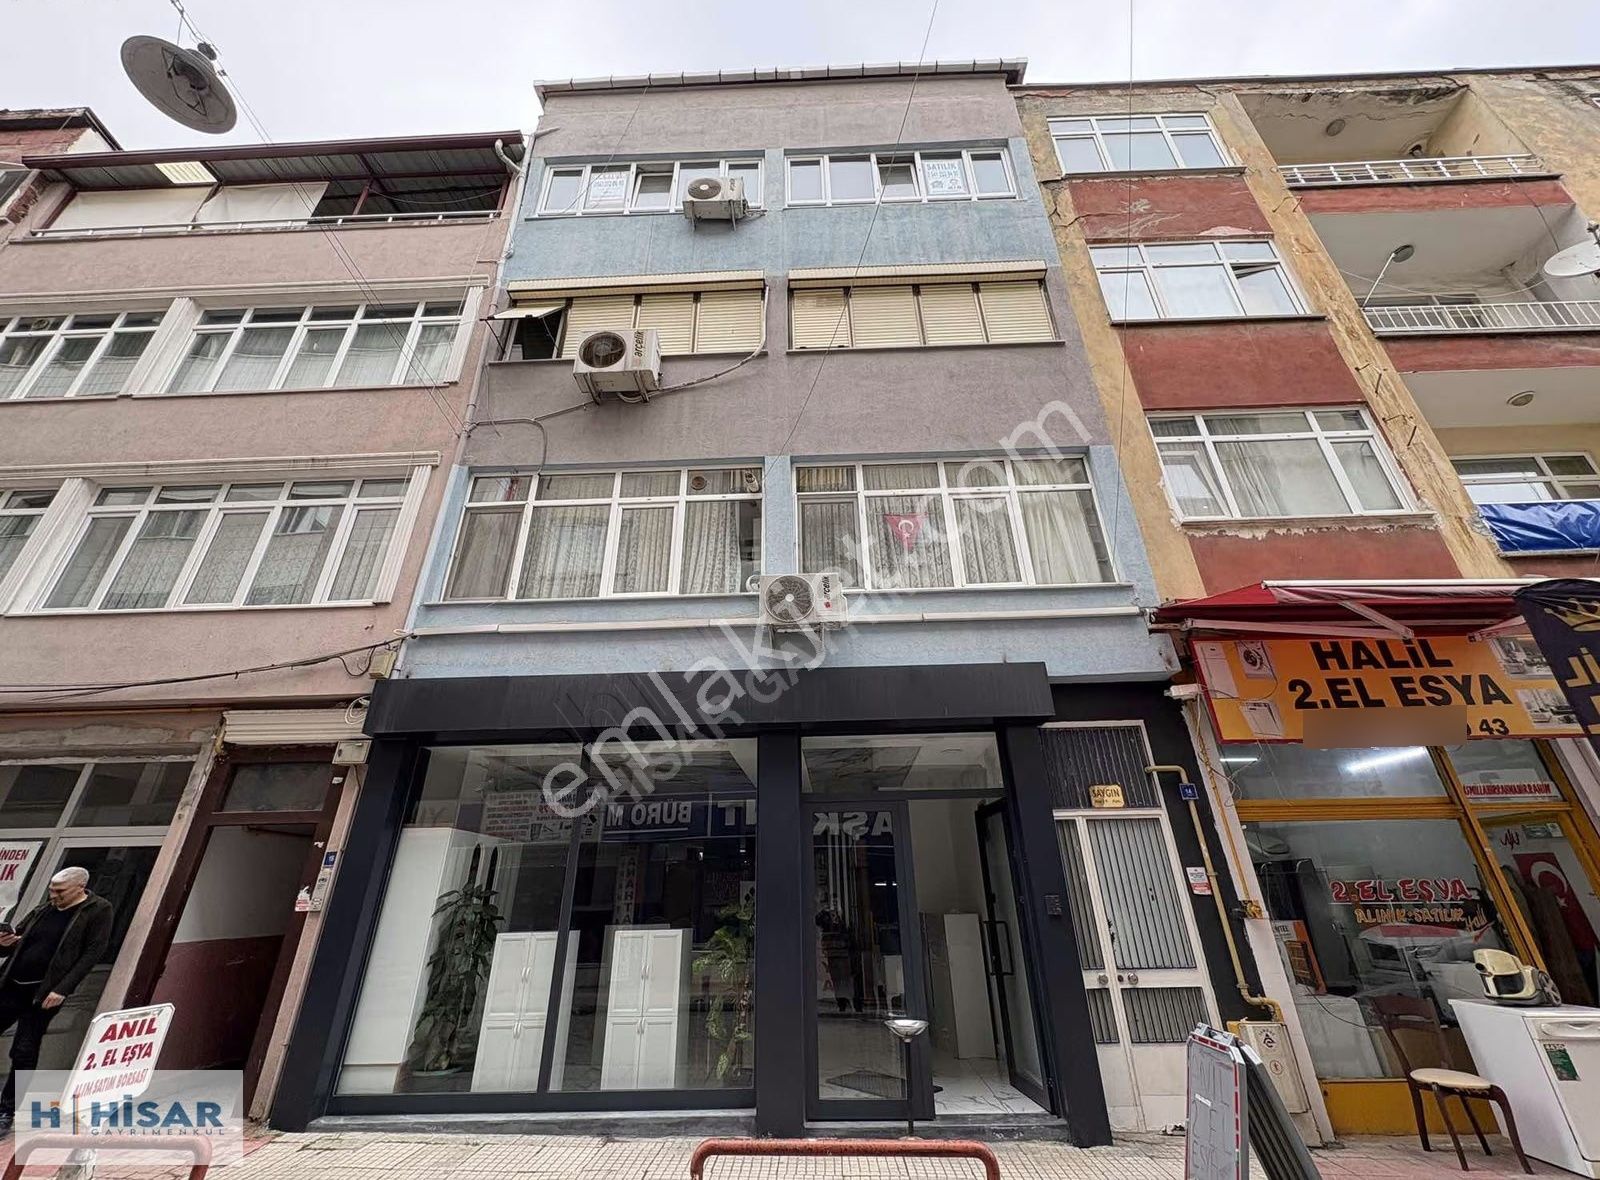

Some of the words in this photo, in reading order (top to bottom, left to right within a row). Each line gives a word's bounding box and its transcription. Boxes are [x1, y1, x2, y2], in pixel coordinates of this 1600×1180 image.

[1287, 677, 1387, 710] 2.EL
[1478, 718, 1510, 736] 43
[1092, 787, 1120, 798] SAYGIN
[98, 1017, 158, 1043] ANIL
[101, 1048, 117, 1067] EL
[120, 1042, 154, 1067] EŞYA
